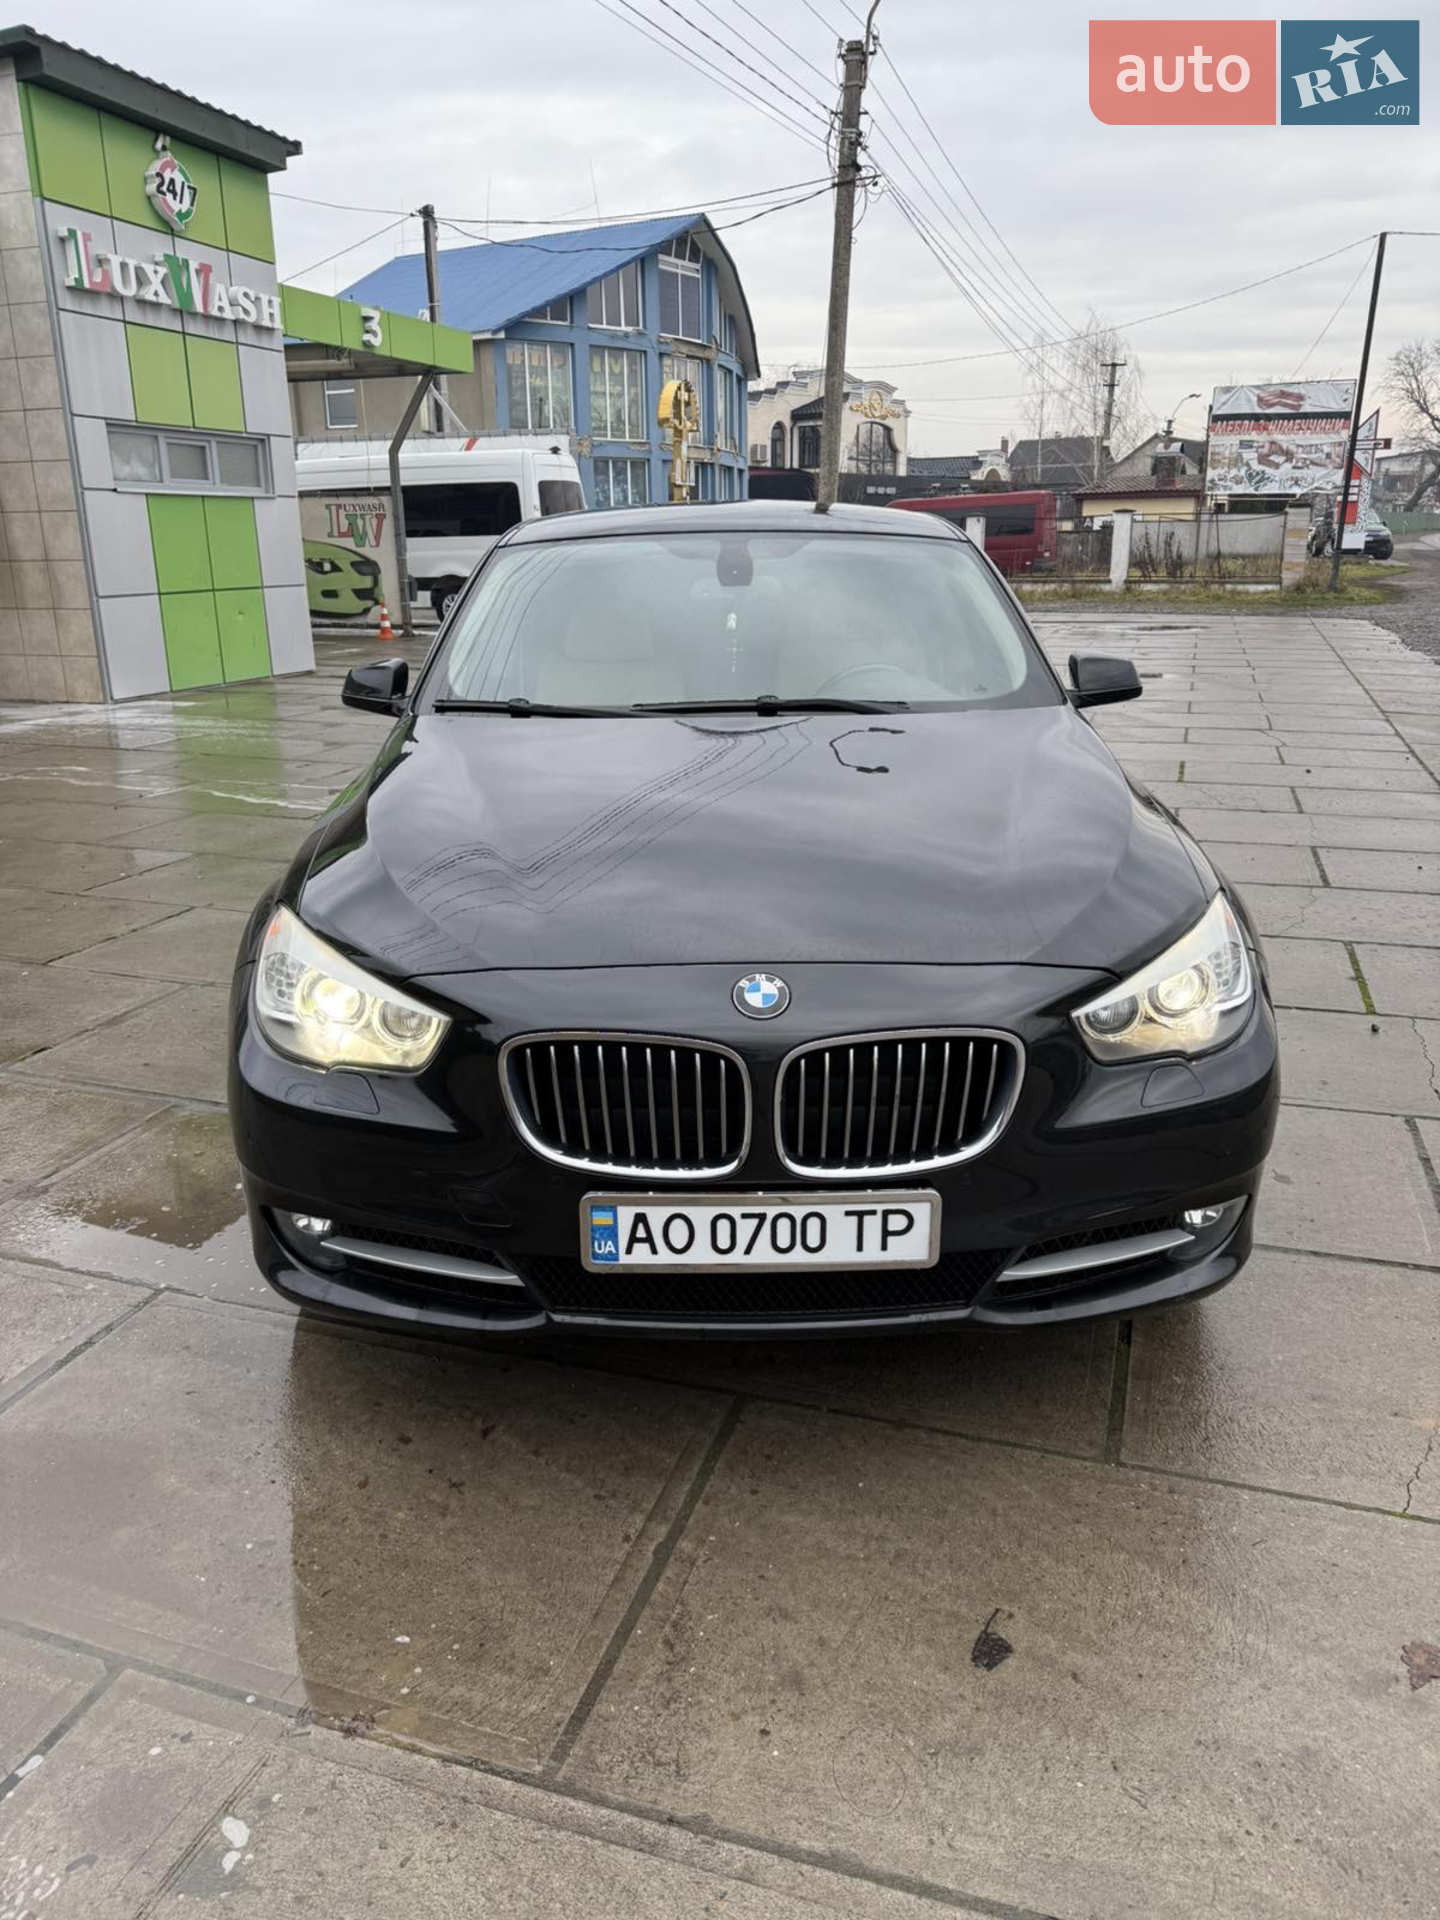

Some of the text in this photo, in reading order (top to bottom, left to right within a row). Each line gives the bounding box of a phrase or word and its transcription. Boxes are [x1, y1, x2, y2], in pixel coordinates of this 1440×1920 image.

[155, 172, 197, 207] 24/7
[361, 307, 383, 347] 3
[594, 1241, 616, 1254] UA
[625, 1208, 915, 1255] AO 0700 TP
